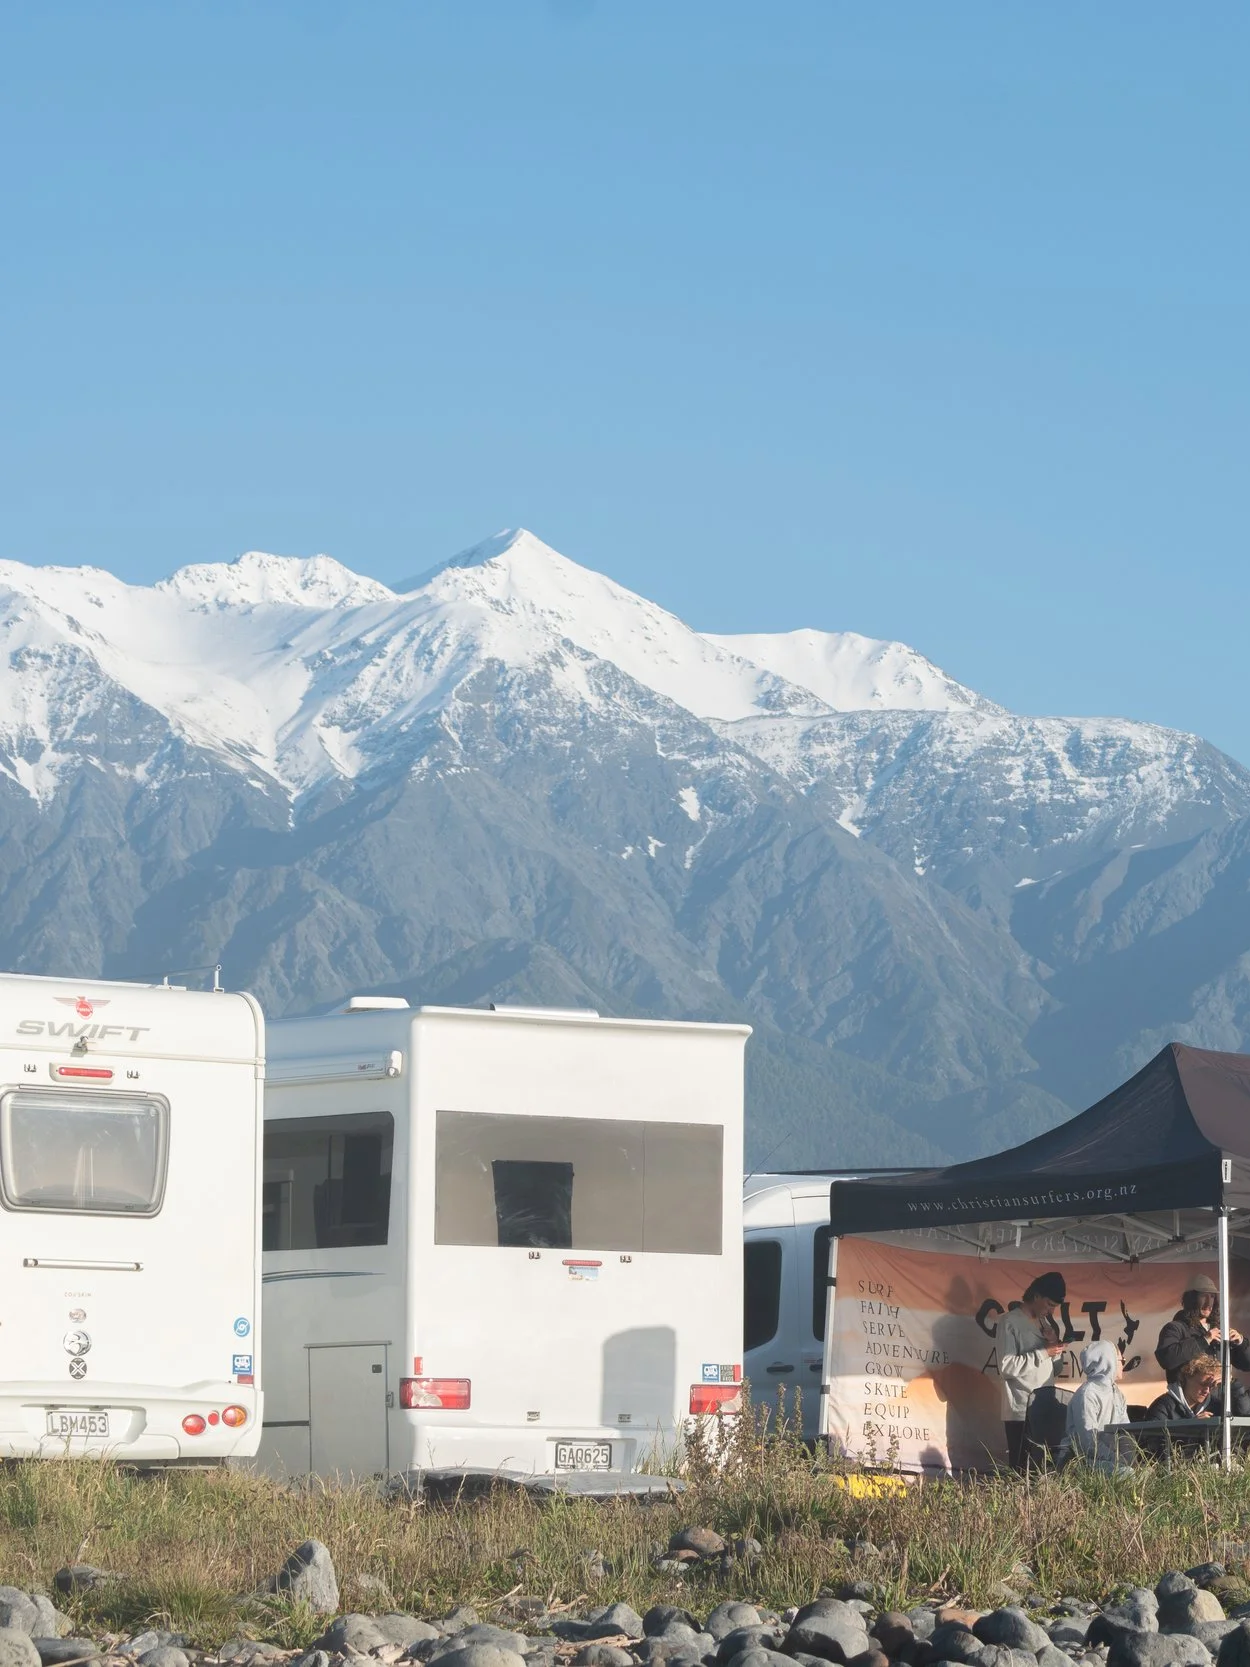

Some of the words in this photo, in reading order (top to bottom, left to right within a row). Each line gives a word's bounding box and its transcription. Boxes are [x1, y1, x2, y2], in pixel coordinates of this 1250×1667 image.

[16, 1020, 151, 1042] SWIFT
[907, 1184, 1138, 1212] www.christiansurfers.org.nz
[859, 1280, 894, 1298] SURF
[861, 1301, 900, 1319] FAITH
[863, 1321, 905, 1338] SERVE
[975, 1299, 1107, 1342] CLT
[865, 1341, 950, 1365] ADVENTURE
[865, 1361, 904, 1378] GROW
[864, 1382, 908, 1399] SKATE
[864, 1403, 910, 1420] EQUIP
[50, 1415, 107, 1433] LBM453
[862, 1422, 930, 1441] EXPLORE
[559, 1447, 609, 1464] GAQ625
